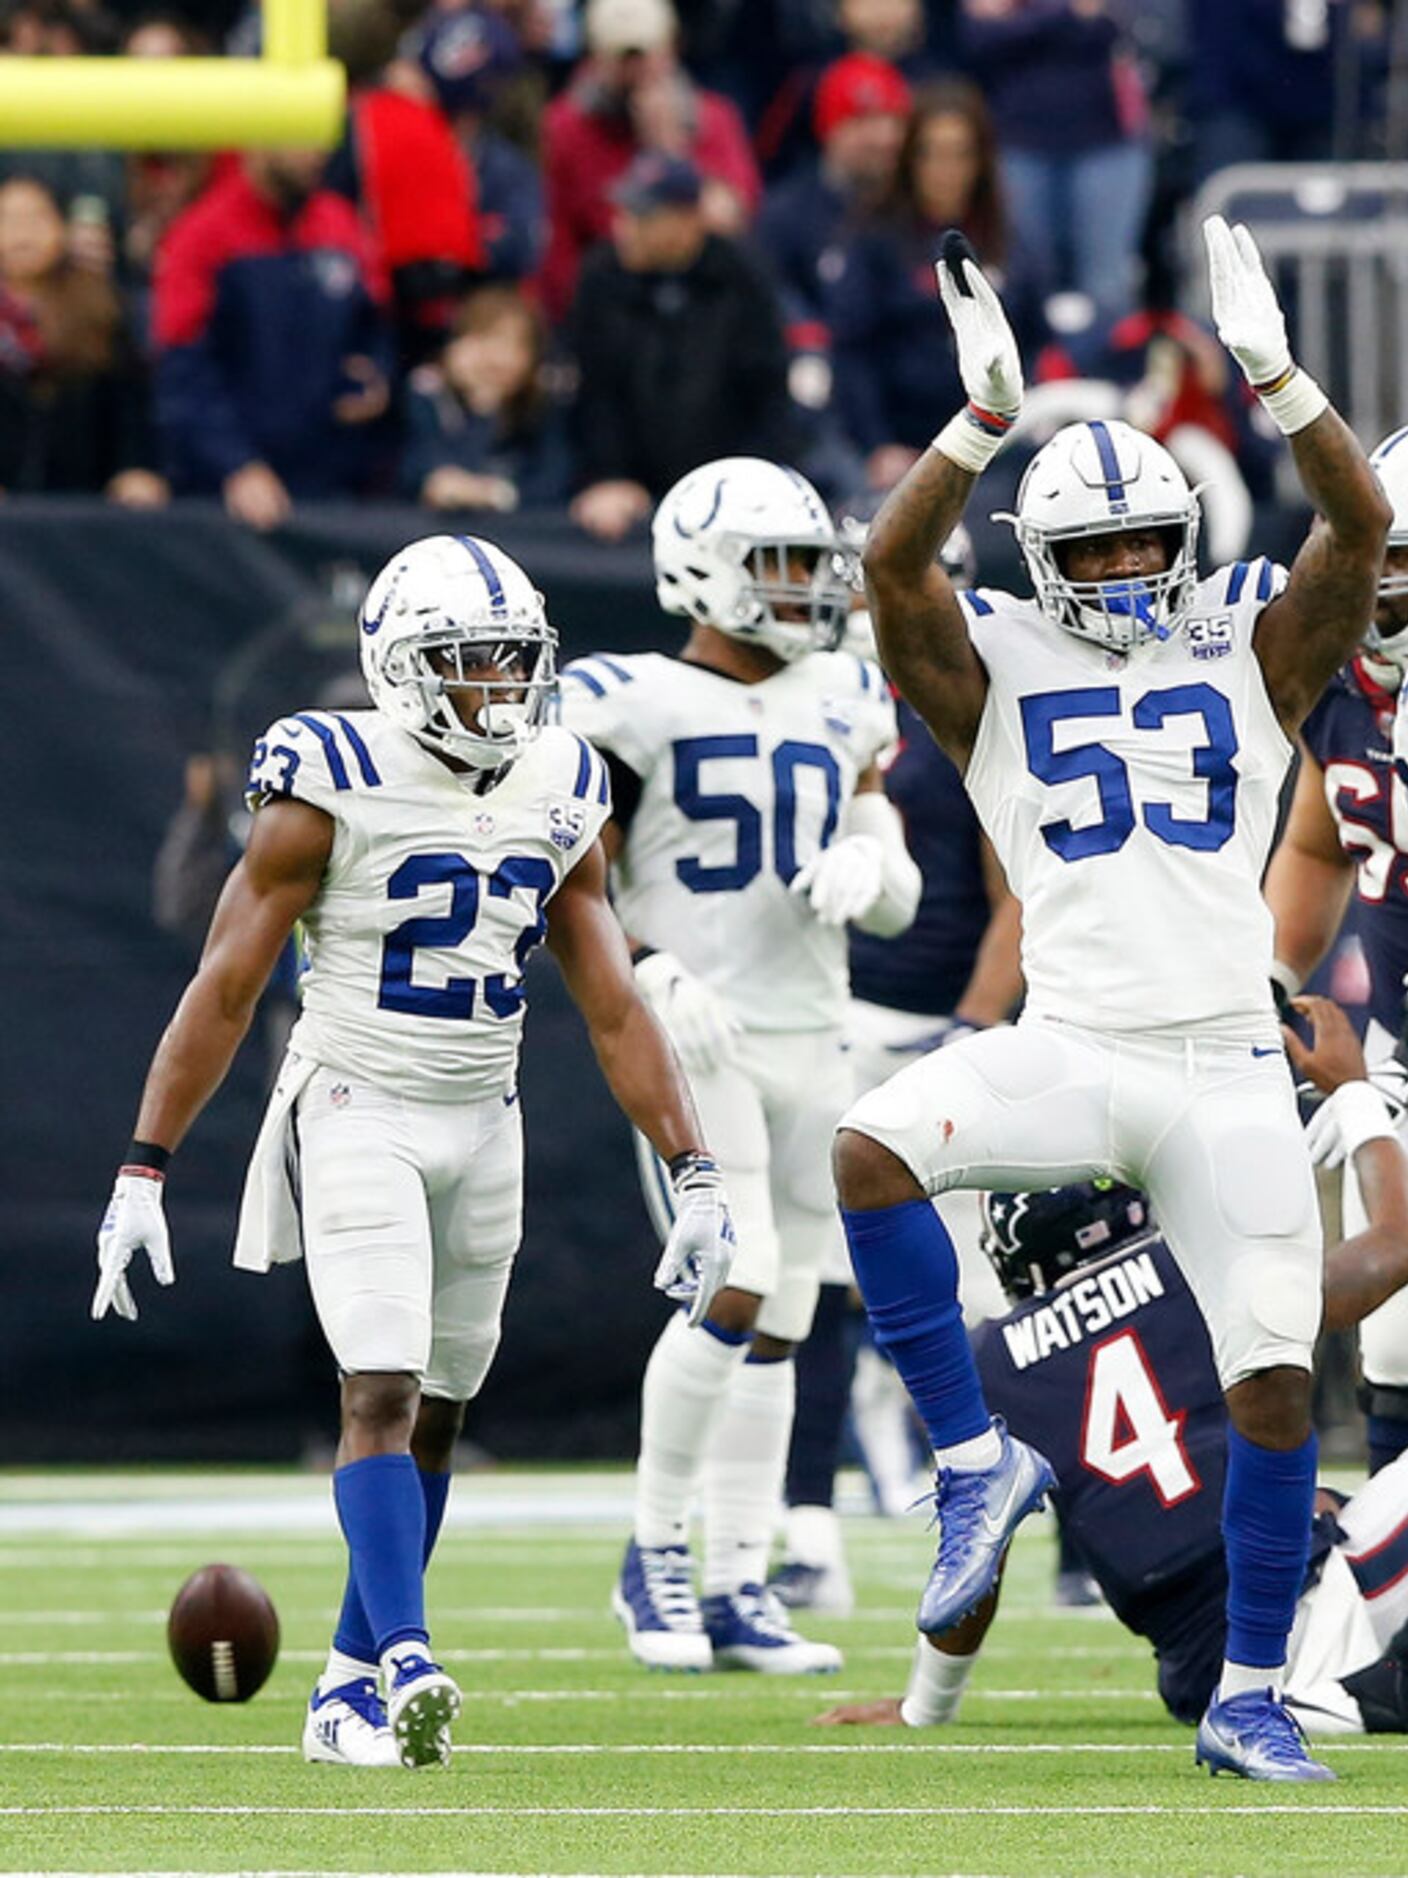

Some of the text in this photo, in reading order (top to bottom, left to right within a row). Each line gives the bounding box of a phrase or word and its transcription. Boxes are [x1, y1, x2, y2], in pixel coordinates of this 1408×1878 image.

[1186, 614, 1232, 645] 35
[248, 742, 301, 794] 23
[671, 733, 842, 894] 50
[1018, 681, 1241, 863] 53
[377, 852, 557, 1020] 23
[1002, 1252, 1165, 1371] WATSON
[1080, 1325, 1203, 1509] 4
